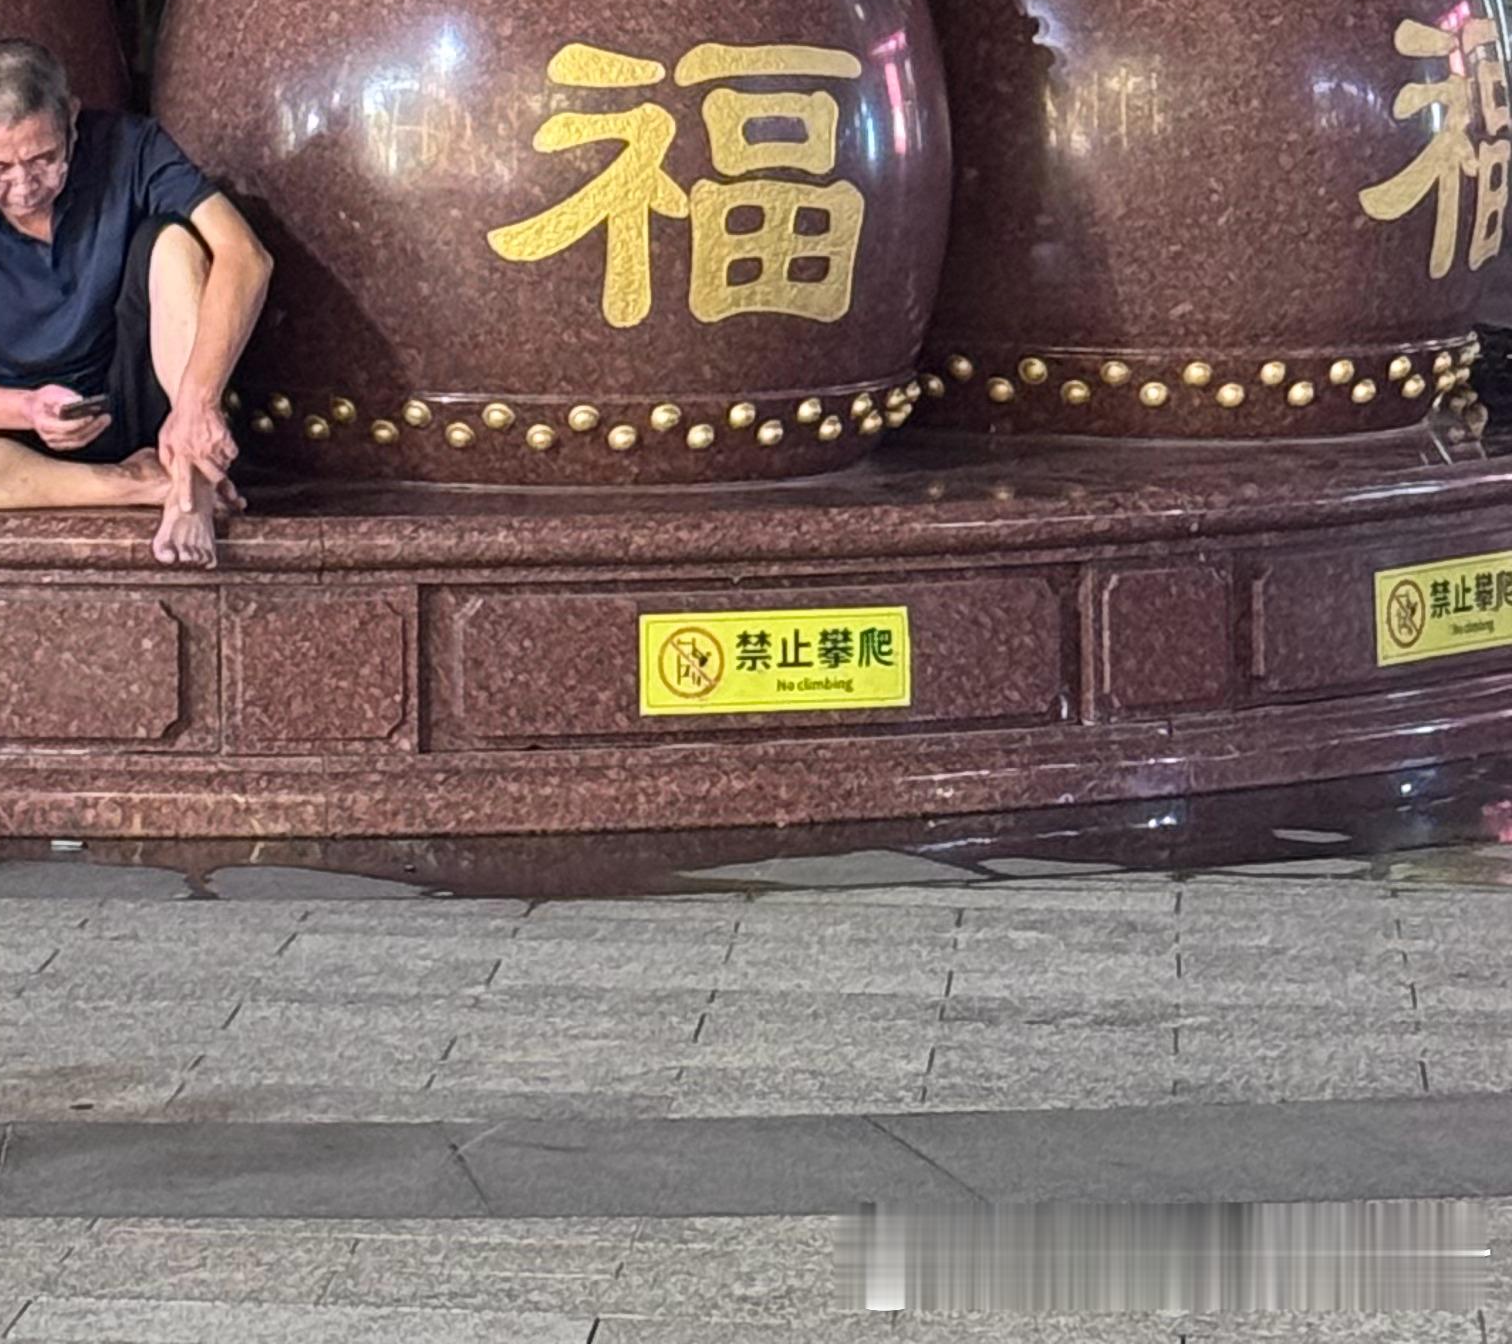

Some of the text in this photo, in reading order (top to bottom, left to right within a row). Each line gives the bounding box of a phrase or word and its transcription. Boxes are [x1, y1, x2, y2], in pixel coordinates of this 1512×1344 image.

[487, 43, 866, 328] 福
[735, 627, 895, 671] 禁止攀爬
[777, 677, 853, 692] No climbing
